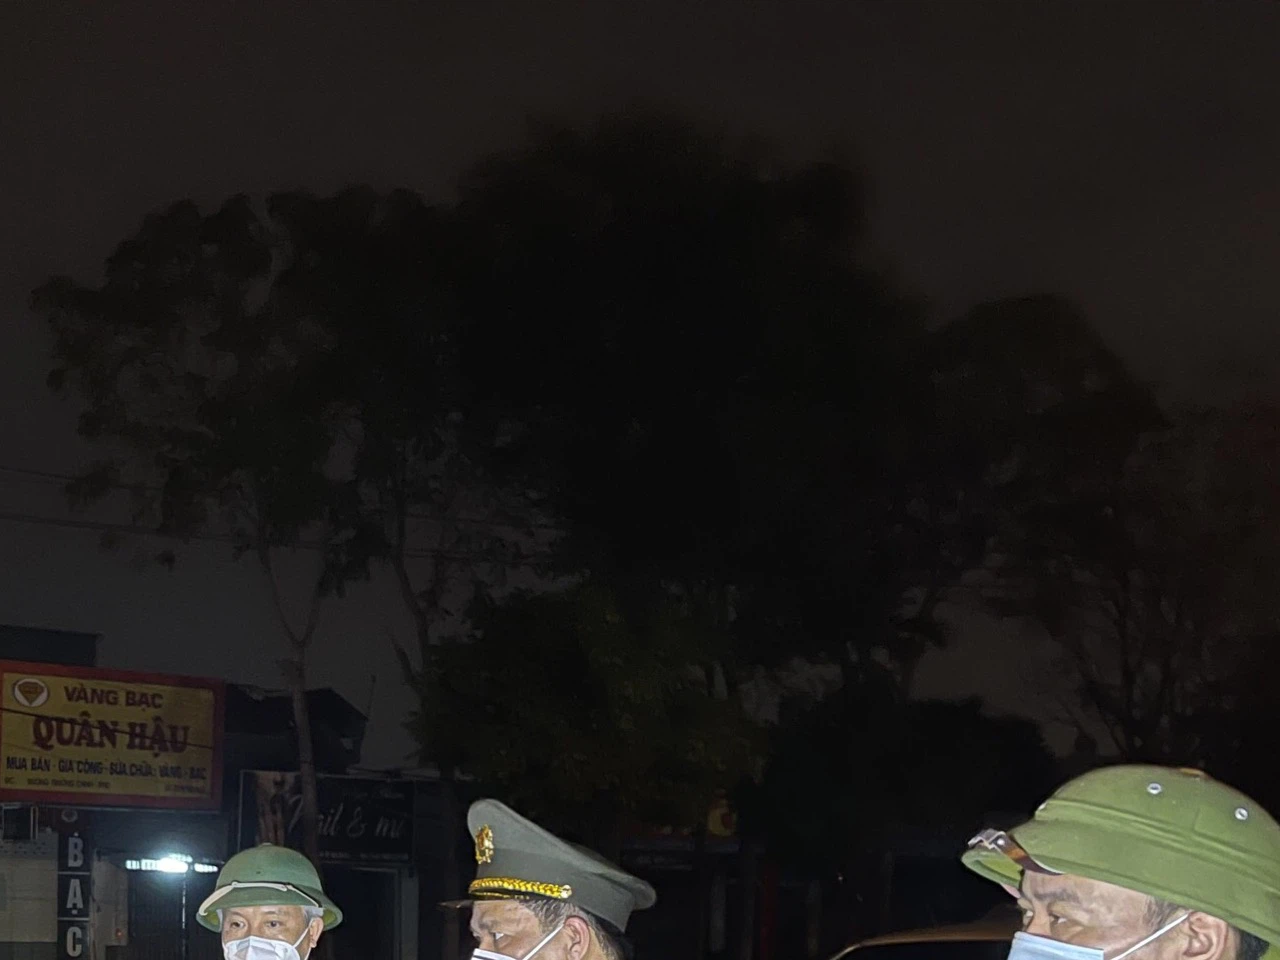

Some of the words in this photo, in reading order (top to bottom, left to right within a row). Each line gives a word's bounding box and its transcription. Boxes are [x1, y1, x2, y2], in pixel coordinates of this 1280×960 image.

[63, 683, 119, 705] VÀNG
[124, 690, 164, 712] BẠC
[32, 710, 119, 751] QUÂN
[127, 715, 191, 758] HẬU
[6, 756, 27, 771] MUA
[58, 758, 74, 773] GIA
